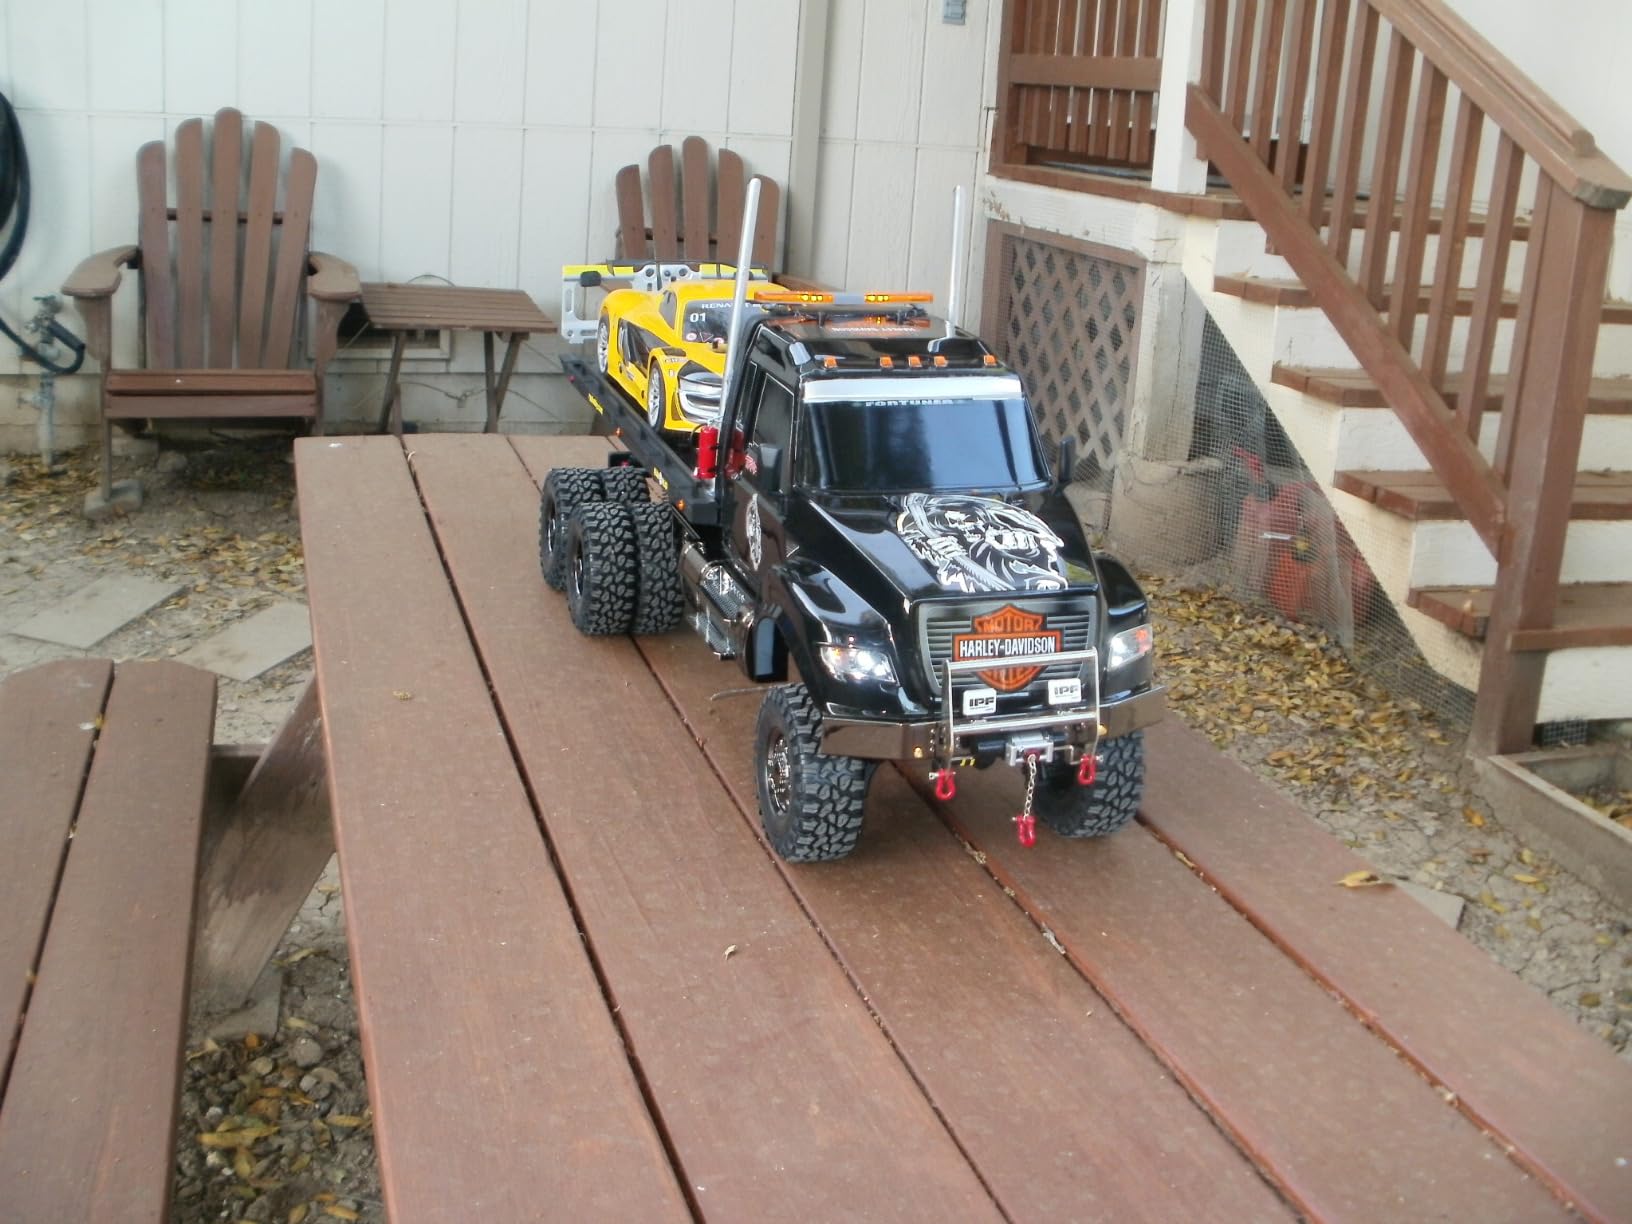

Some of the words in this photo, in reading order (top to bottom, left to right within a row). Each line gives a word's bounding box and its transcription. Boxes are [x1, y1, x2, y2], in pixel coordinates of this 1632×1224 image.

[689, 312, 706, 323] 01
[983, 615, 1035, 633] MOTOR
[959, 636, 1056, 658] HARLEY-DAVIDSON
[1054, 685, 1079, 695] IPF
[969, 696, 995, 707] IPF
